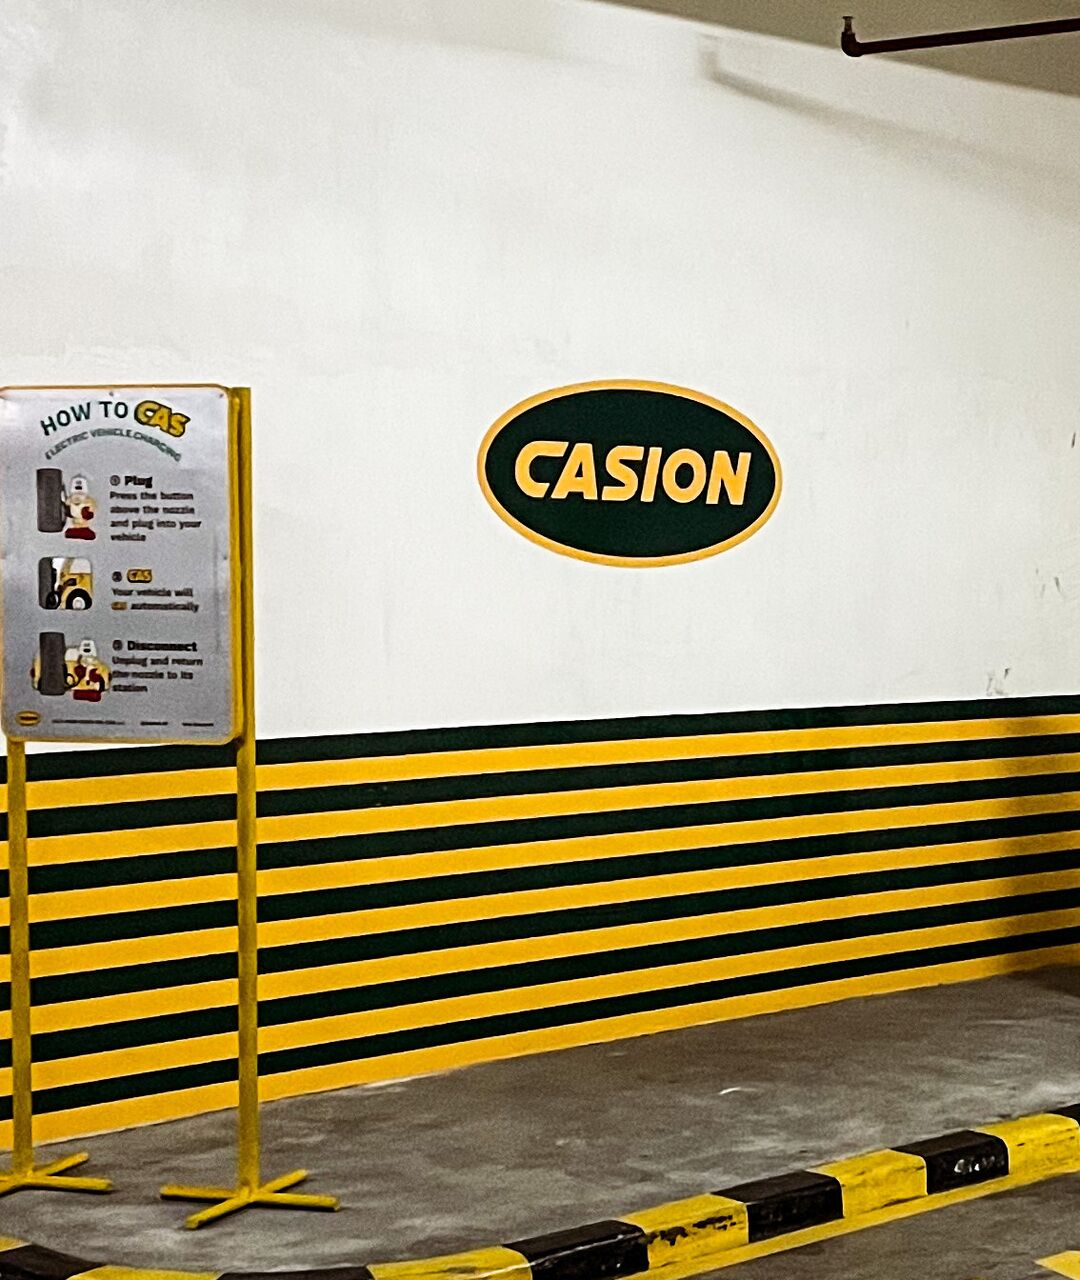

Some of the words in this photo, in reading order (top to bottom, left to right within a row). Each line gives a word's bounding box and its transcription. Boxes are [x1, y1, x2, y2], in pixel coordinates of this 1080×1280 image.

[40, 402, 91, 436] HOW
[99, 401, 129, 419] TO
[45, 431, 89, 460] ELECTRIC
[90, 428, 132, 438] VEHICLE
[133, 431, 182, 462] CHARGING
[514, 440, 752, 506] CASION
[124, 475, 153, 488] Plug
[109, 491, 137, 500] Press
[140, 492, 157, 500] the
[160, 492, 194, 500] button
[110, 506, 140, 514] above
[142, 506, 159, 514] the
[162, 506, 195, 515] nozzle
[110, 519, 129, 528] and
[131, 519, 154, 530] plug
[156, 519, 177, 528] into
[178, 521, 202, 530] your
[110, 533, 146, 541] vehicle
[111, 588, 134, 596] Your
[136, 588, 171, 597] vehicle
[174, 588, 194, 597] will
[127, 640, 197, 652] Disconnect
[112, 656, 148, 667] Unplug
[150, 656, 169, 665] and
[171, 658, 203, 666] return
[112, 670, 130, 678] the
[131, 670, 164, 679] nozzle
[167, 671, 178, 680] to
[180, 671, 194, 680] its
